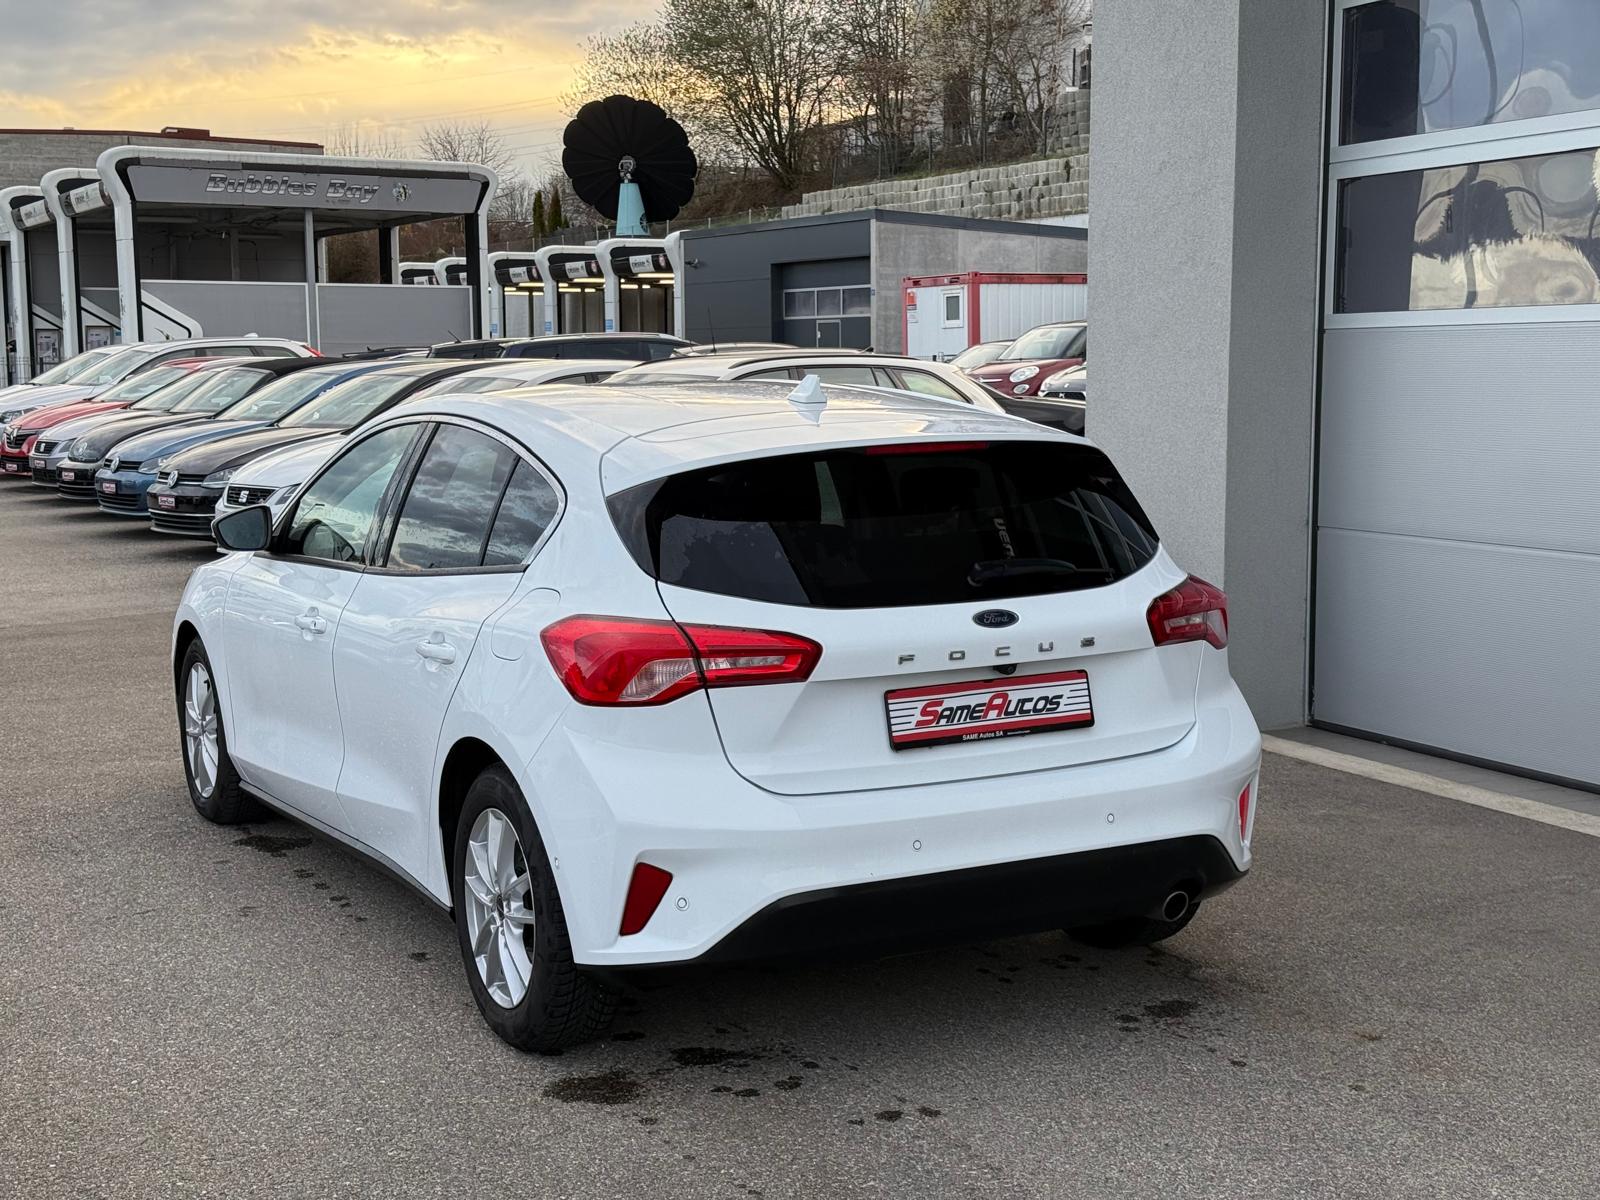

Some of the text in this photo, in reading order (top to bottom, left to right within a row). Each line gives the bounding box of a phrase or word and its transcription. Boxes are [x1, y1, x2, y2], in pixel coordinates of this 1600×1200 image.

[206, 173, 380, 203] Bubbles Bay
[898, 637, 1095, 665] FOCUS
